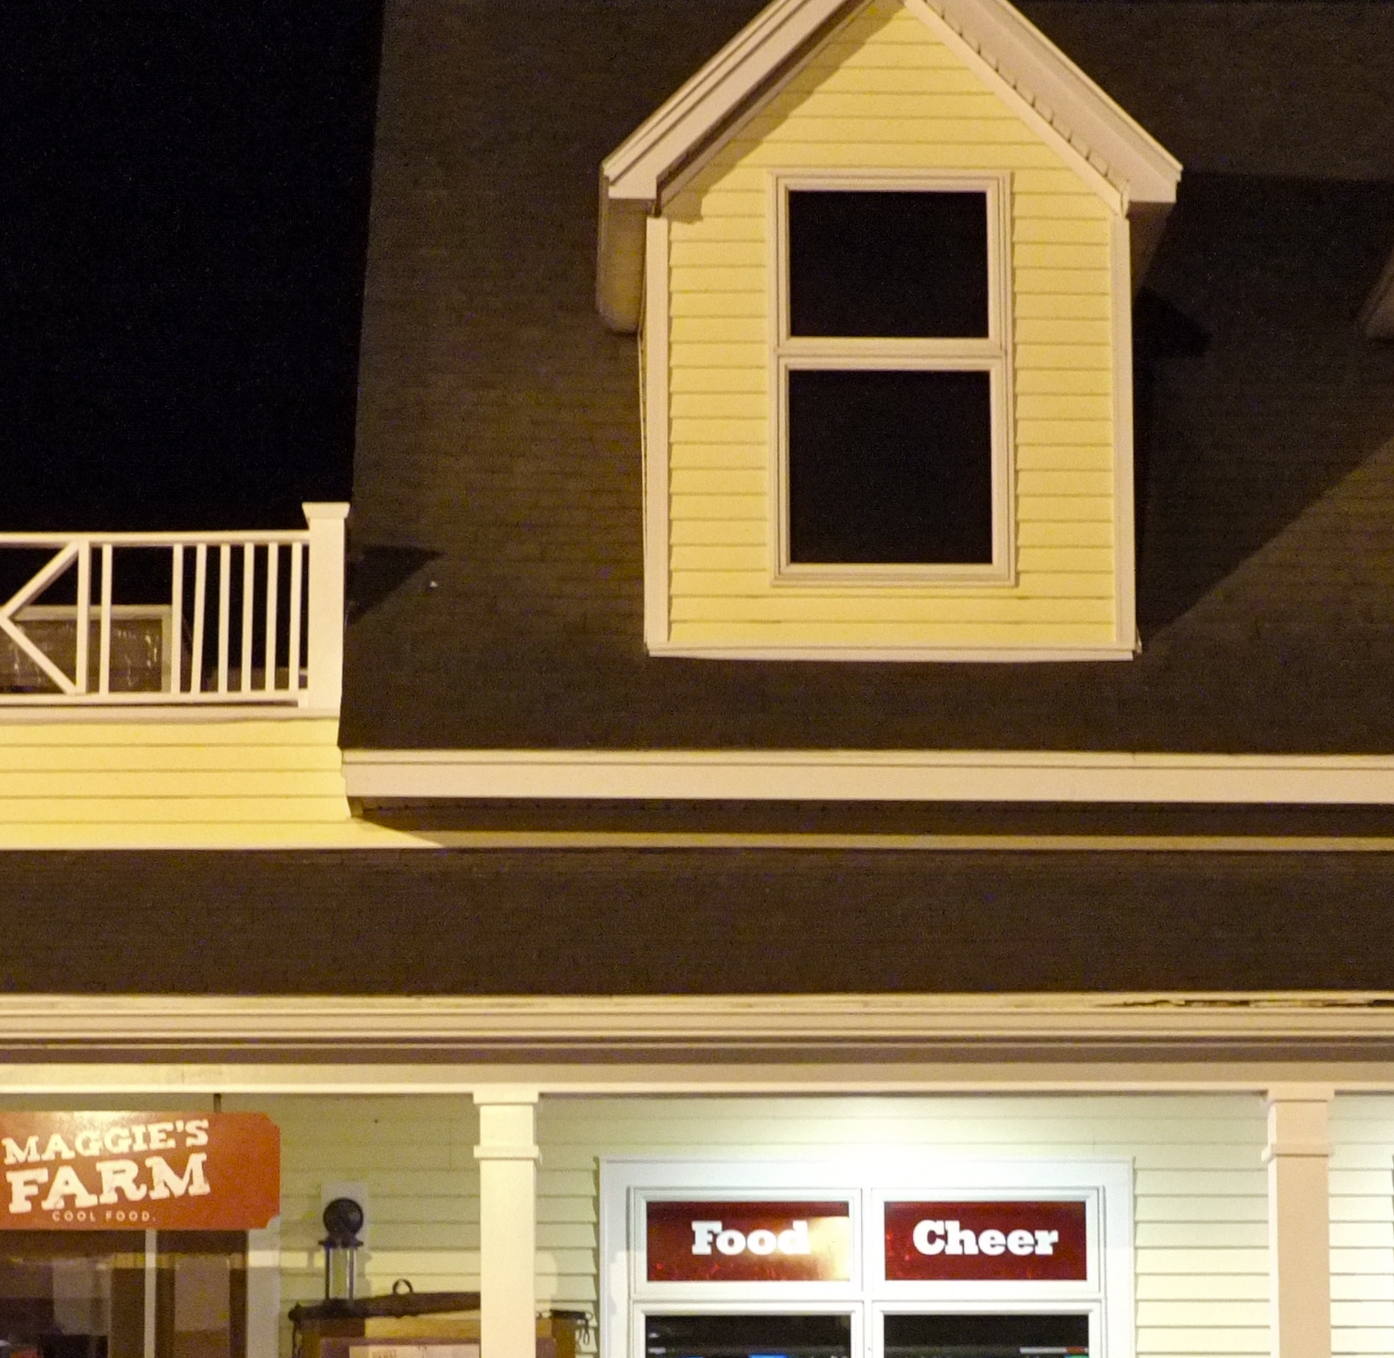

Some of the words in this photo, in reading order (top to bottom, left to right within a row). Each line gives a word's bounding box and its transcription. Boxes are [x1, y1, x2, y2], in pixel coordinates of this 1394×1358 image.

[1, 1119, 209, 1165] MAGGIE'S
[6, 1152, 211, 1214] FARM
[52, 1210, 96, 1222] COOL
[691, 1220, 811, 1256] Food
[912, 1219, 1059, 1256] Cheer
